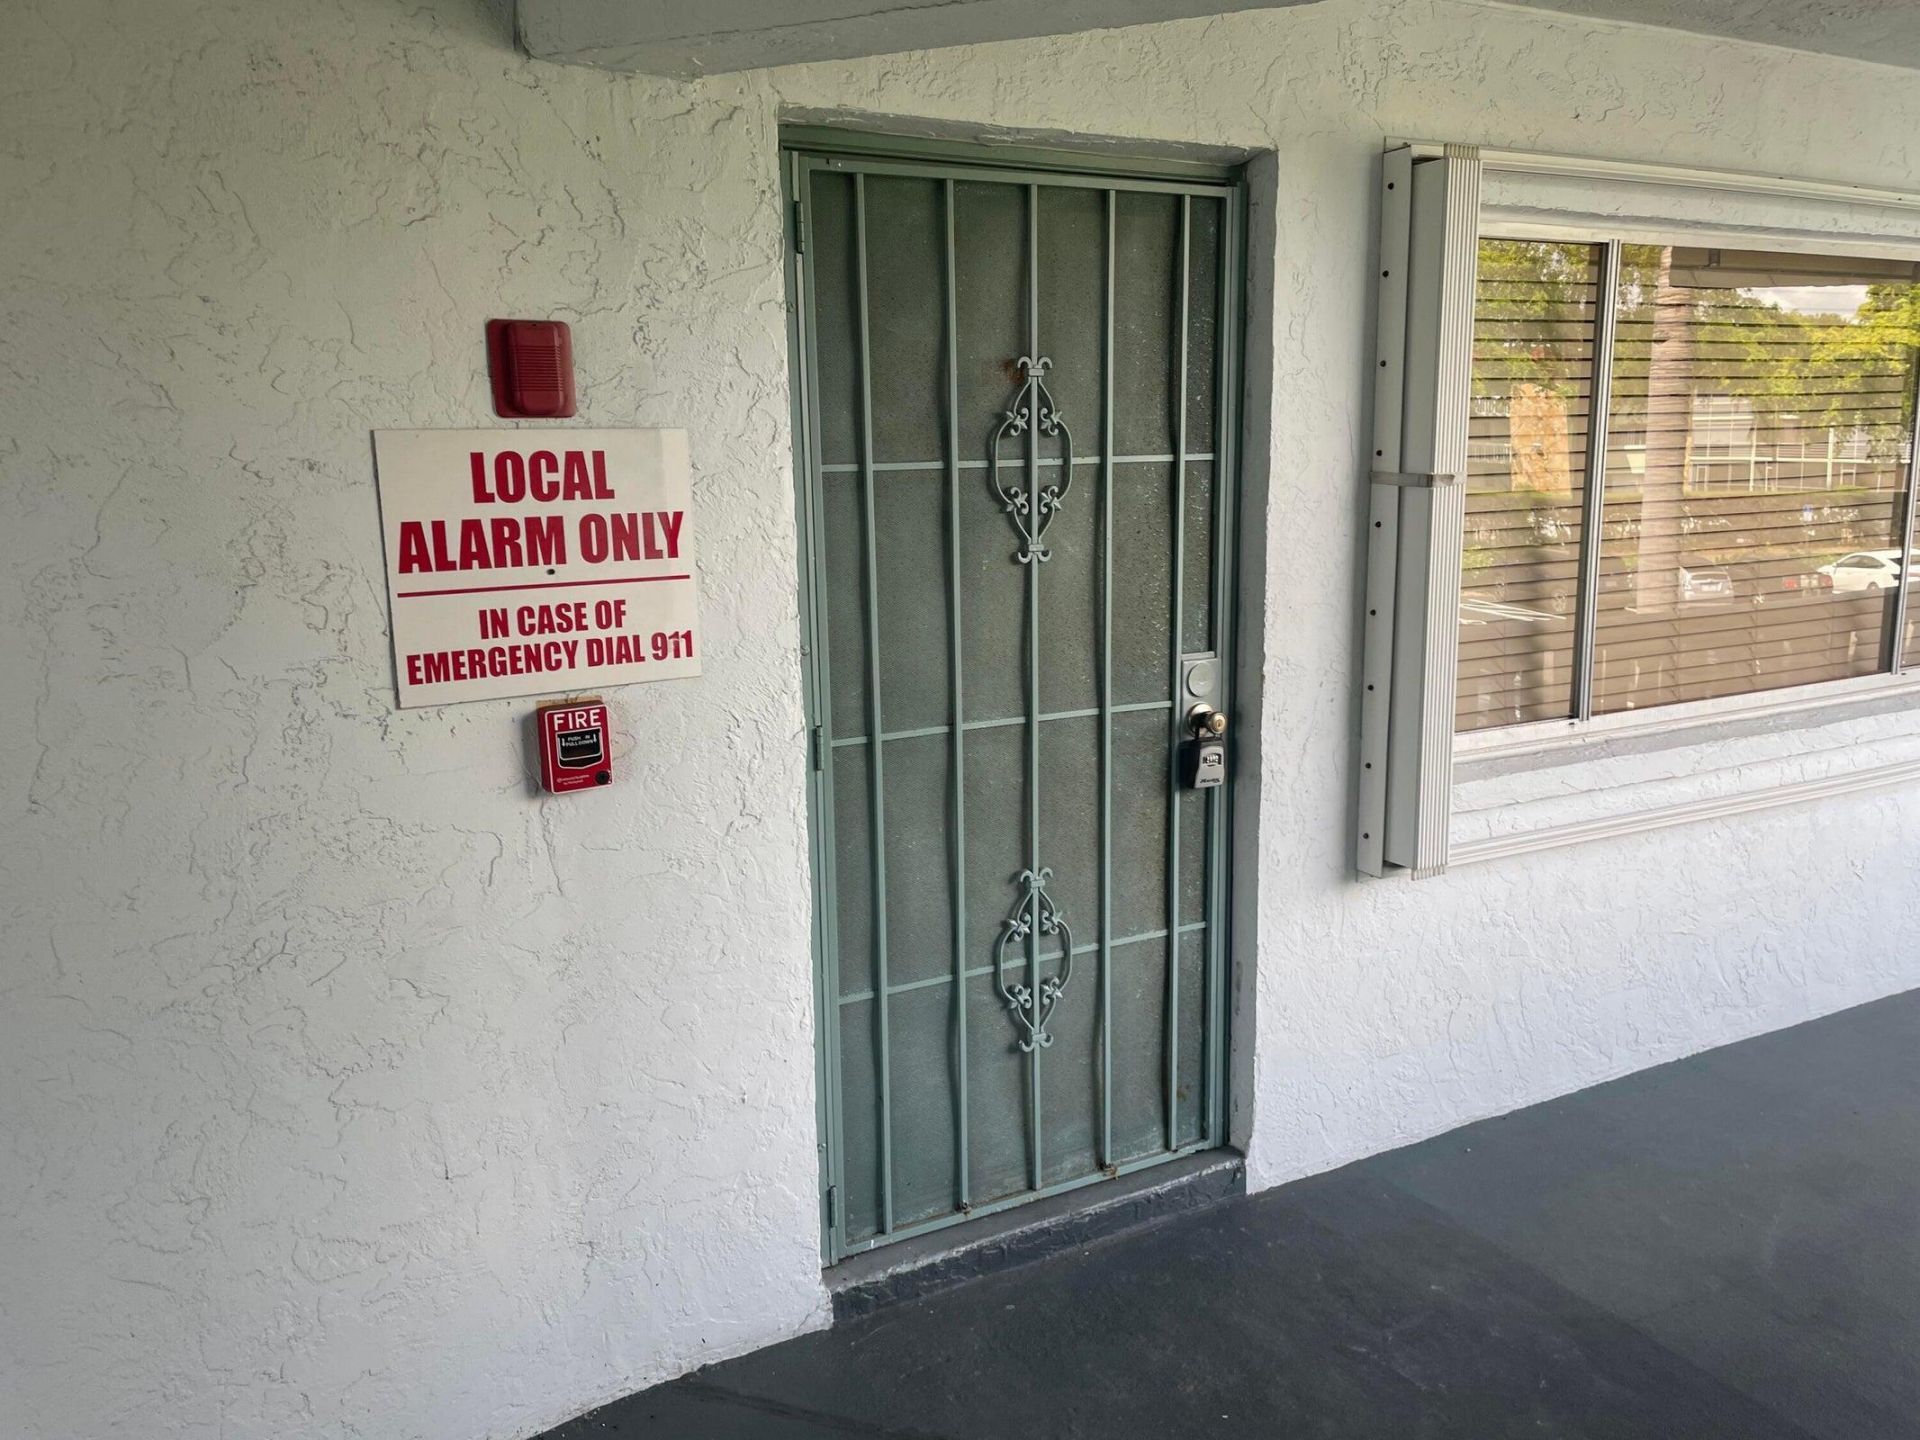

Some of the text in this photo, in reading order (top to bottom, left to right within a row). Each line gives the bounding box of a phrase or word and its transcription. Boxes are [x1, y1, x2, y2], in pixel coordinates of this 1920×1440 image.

[470, 450, 615, 504] LOCAL
[398, 511, 684, 574] ALARM ONLY
[478, 599, 627, 640] IN CASE OF
[406, 630, 694, 686] EMERGENCY DIAL 911
[553, 709, 602, 731] FIRE
